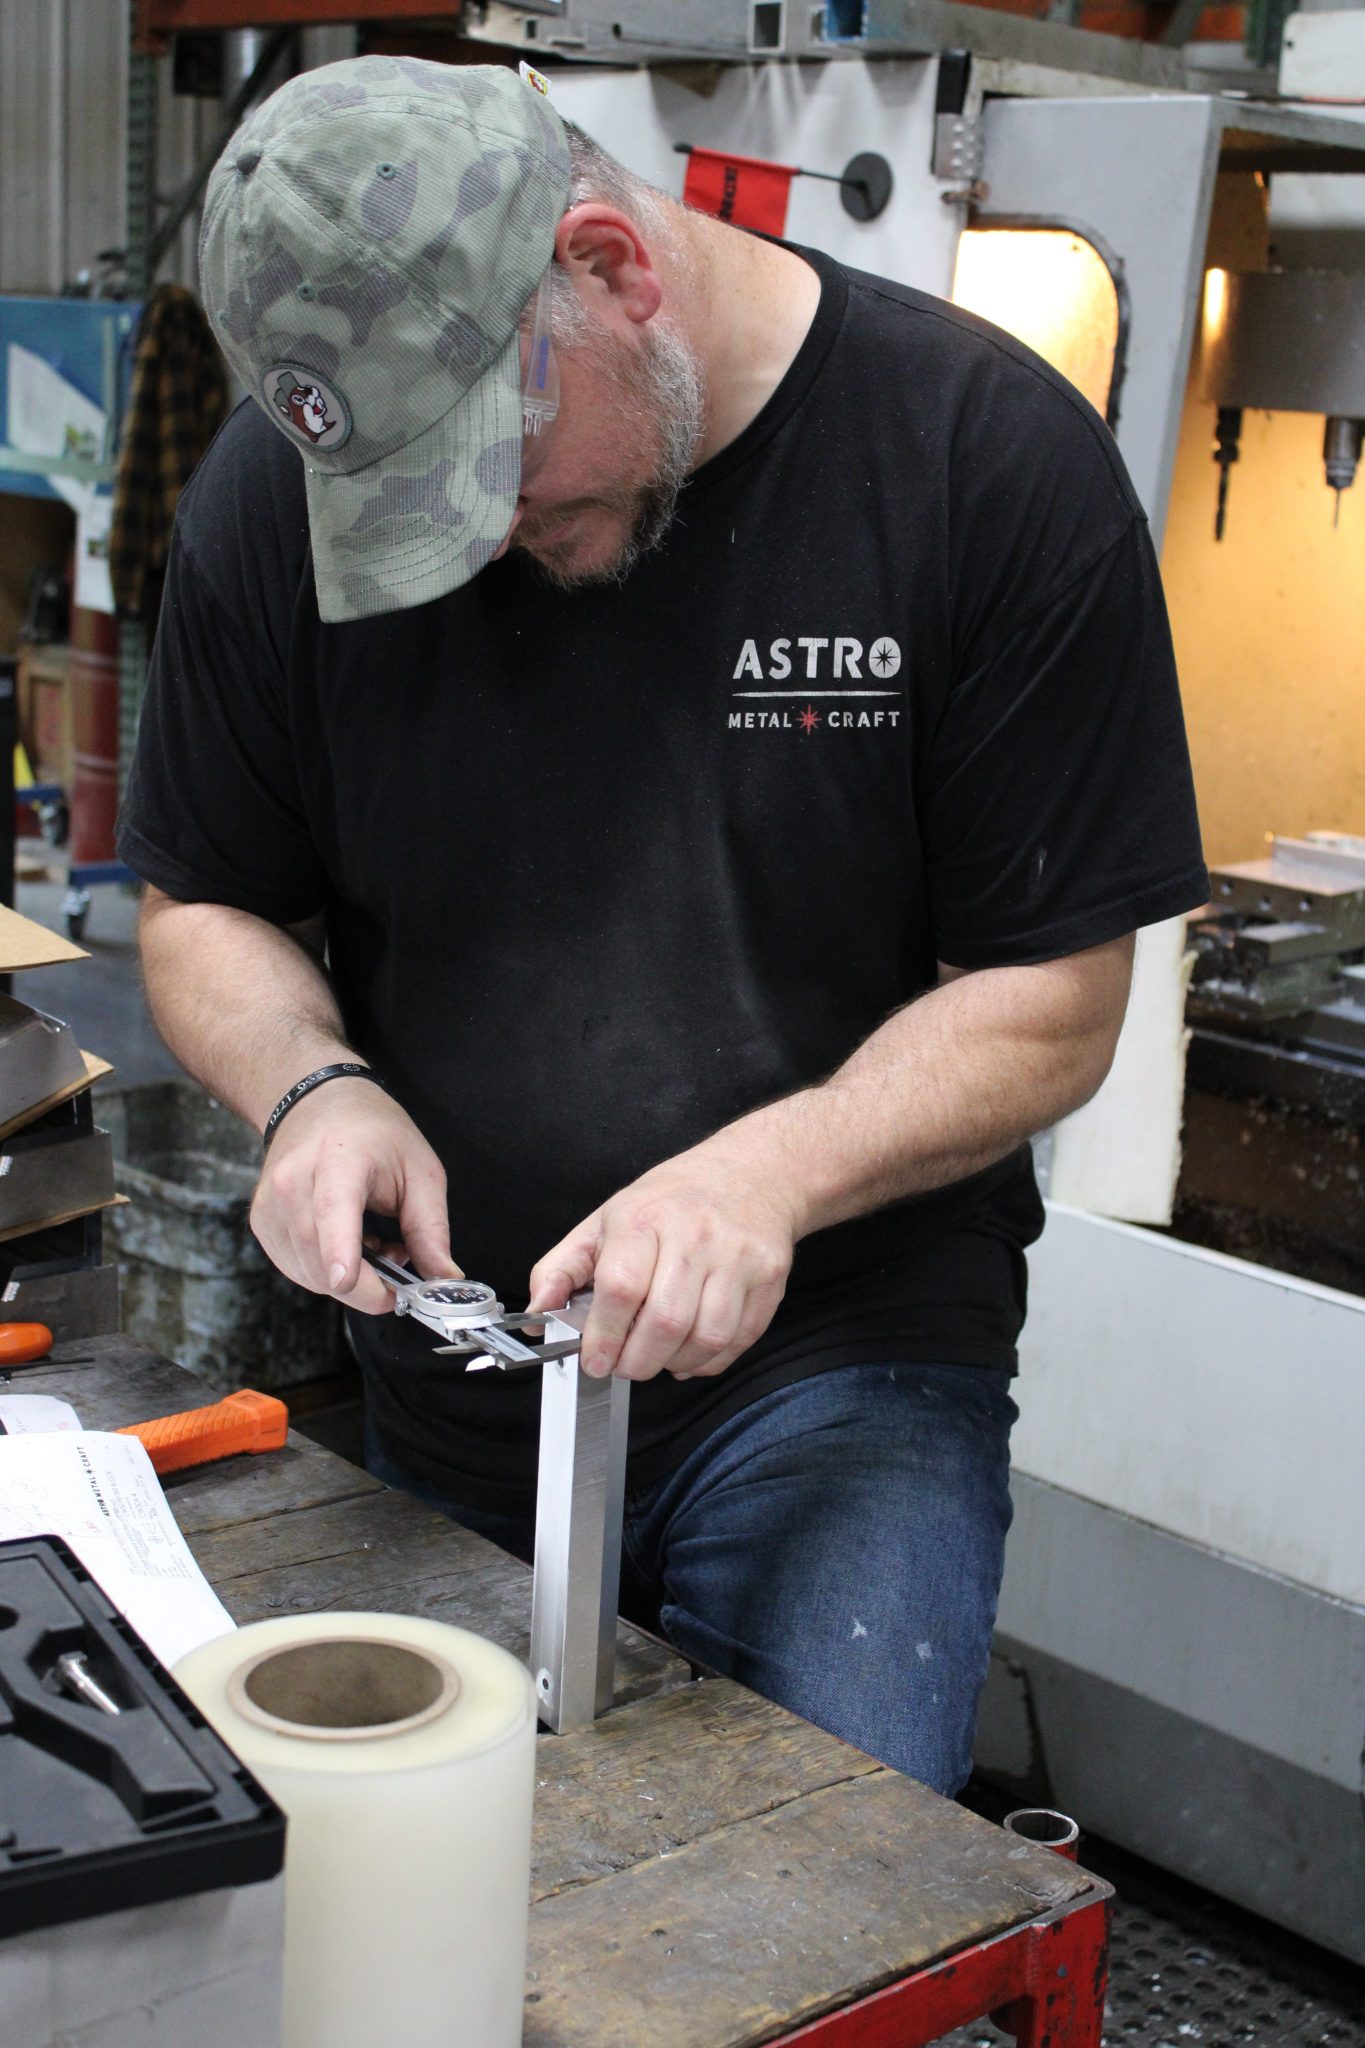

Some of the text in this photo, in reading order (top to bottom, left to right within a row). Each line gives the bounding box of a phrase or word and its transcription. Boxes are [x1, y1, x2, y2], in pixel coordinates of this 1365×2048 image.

[732, 636, 902, 680] ASTRO
[728, 711, 900, 729] METAL CRAFT
[76, 1446, 90, 1467] CRAFT
[89, 1476, 102, 1498] METAL
